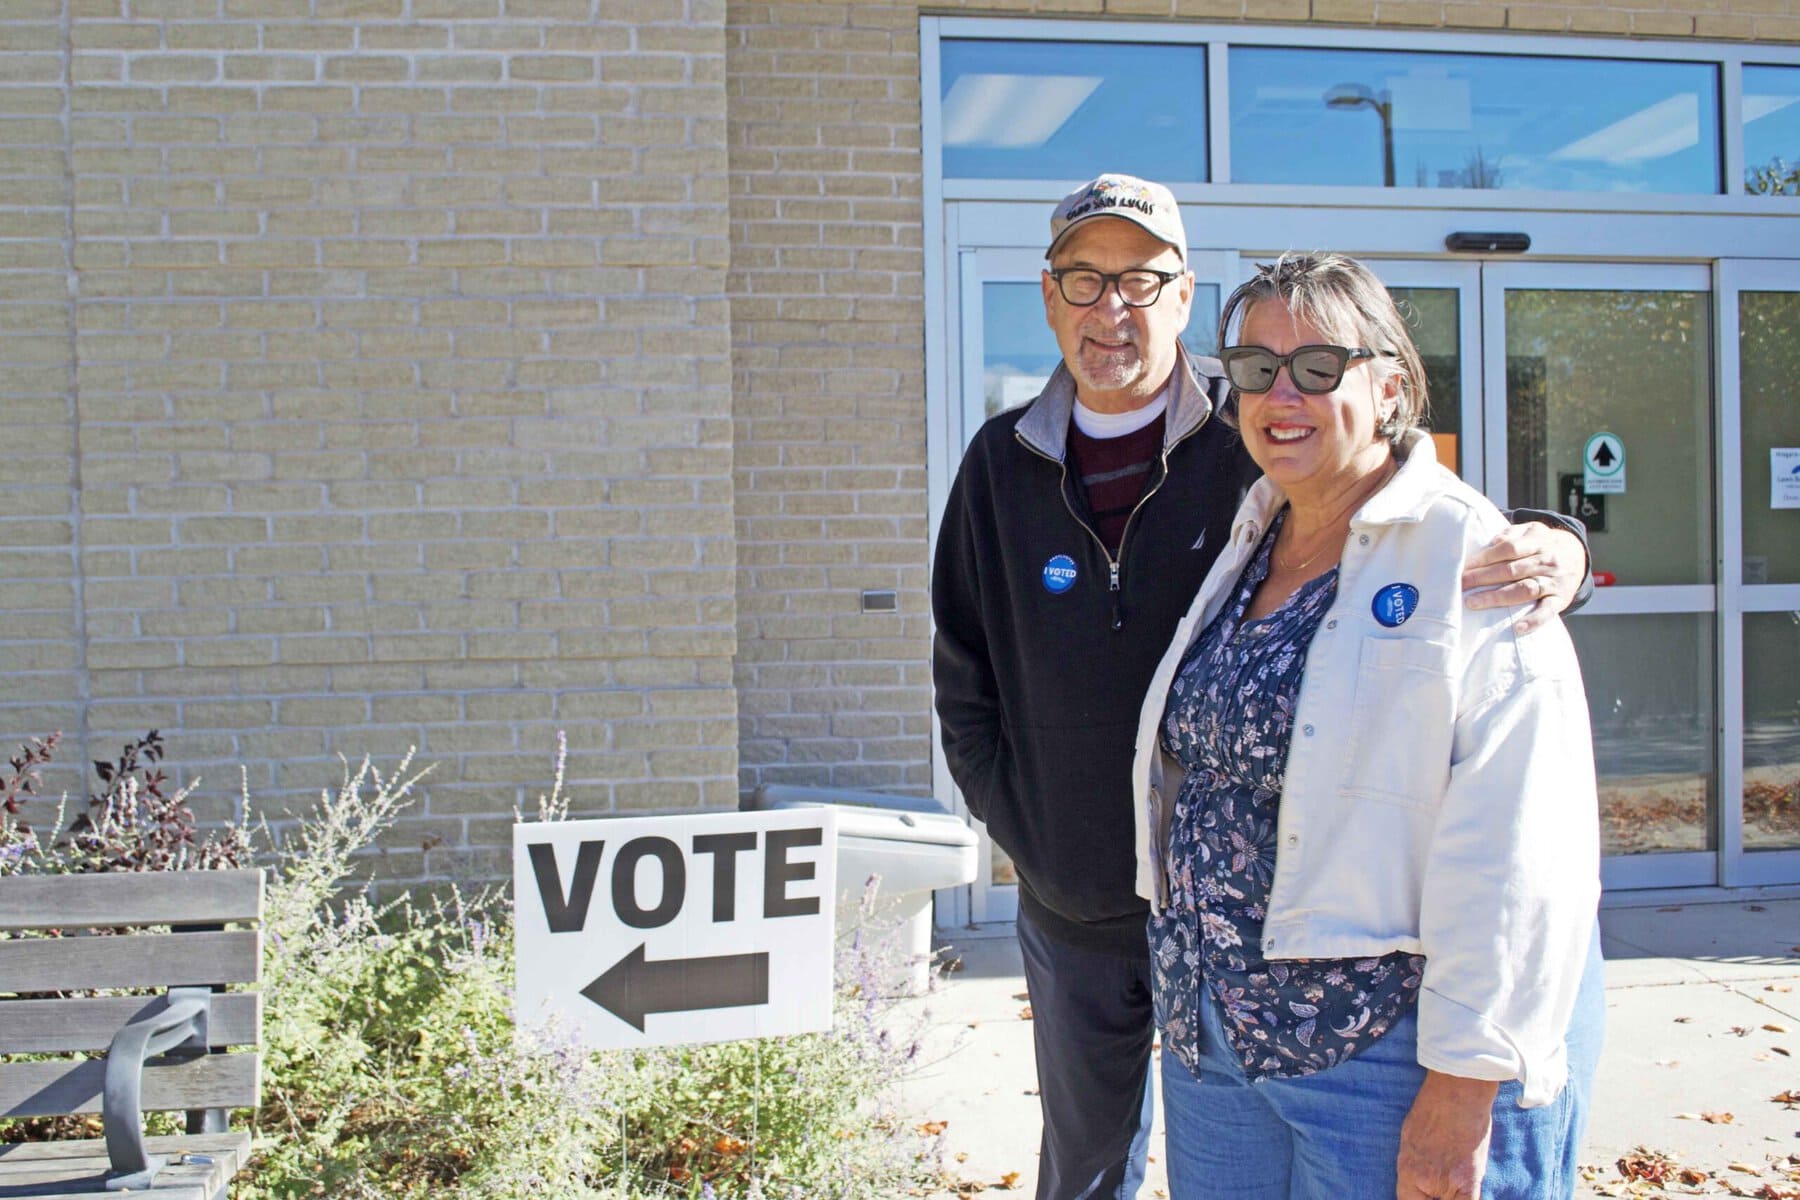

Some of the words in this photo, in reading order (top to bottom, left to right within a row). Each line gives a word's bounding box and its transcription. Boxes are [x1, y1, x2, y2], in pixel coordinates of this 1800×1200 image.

[1093, 196, 1117, 209] SAN
[1119, 197, 1155, 215] LUCAS
[1049, 567, 1077, 578] VOTED
[1392, 591, 1405, 624] VOTED
[527, 827, 823, 934] VOTE
